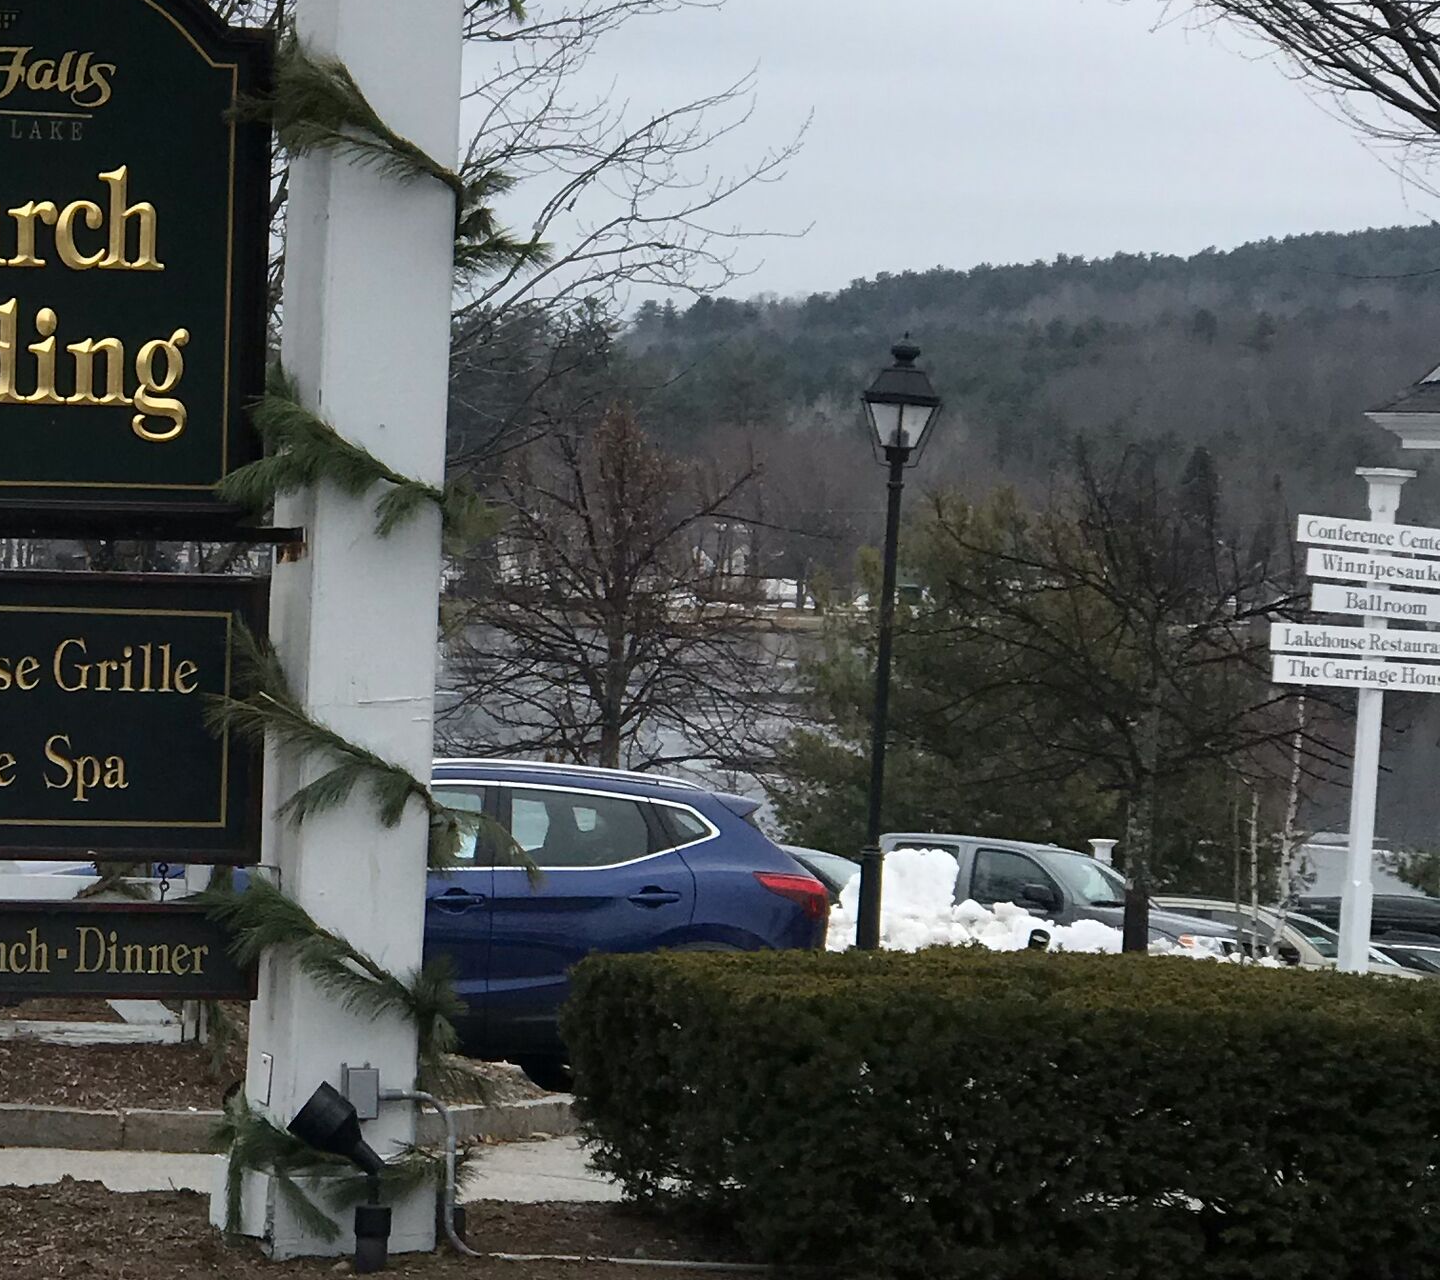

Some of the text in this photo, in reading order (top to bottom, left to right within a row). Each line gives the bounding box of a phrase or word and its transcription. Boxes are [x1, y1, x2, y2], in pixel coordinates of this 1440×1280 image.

[10, 119, 85, 142] LAKE
[1306, 520, 1395, 546] Conference
[1322, 552, 1440, 582] Winnipesauk
[1345, 591, 1428, 616] Ballroom
[1284, 628, 1440, 655] Lakehouse Restaura
[53, 638, 199, 695] Grille
[1288, 658, 1320, 678] The
[1322, 661, 1398, 687] Carriage
[43, 734, 129, 802] Spa
[75, 926, 210, 976] Dinner
